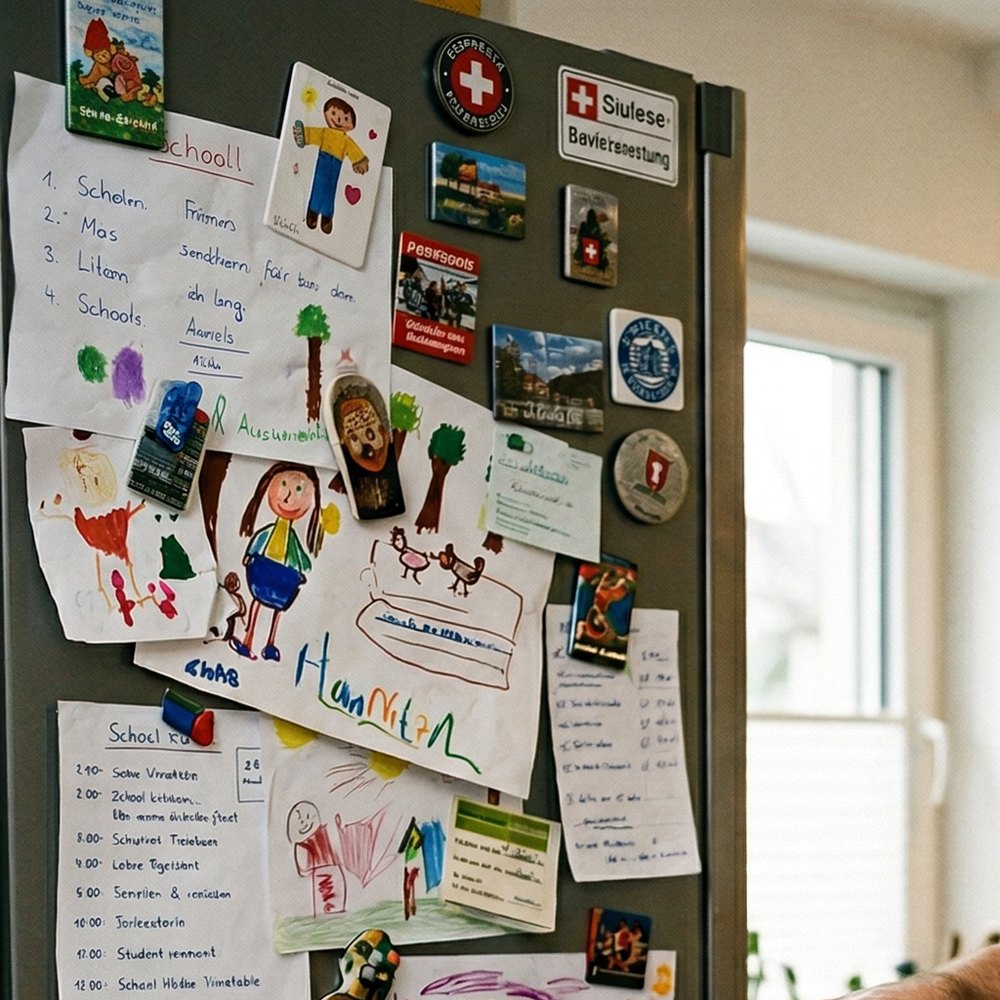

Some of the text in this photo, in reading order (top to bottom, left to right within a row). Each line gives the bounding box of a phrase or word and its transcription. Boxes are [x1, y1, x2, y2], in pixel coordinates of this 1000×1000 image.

[42, 171, 57, 190] 1.
[81, 216, 118, 242] Mas
[44, 245, 59, 264] 3.
[44, 284, 60, 306] 4.
[117, 947, 164, 960] Student
